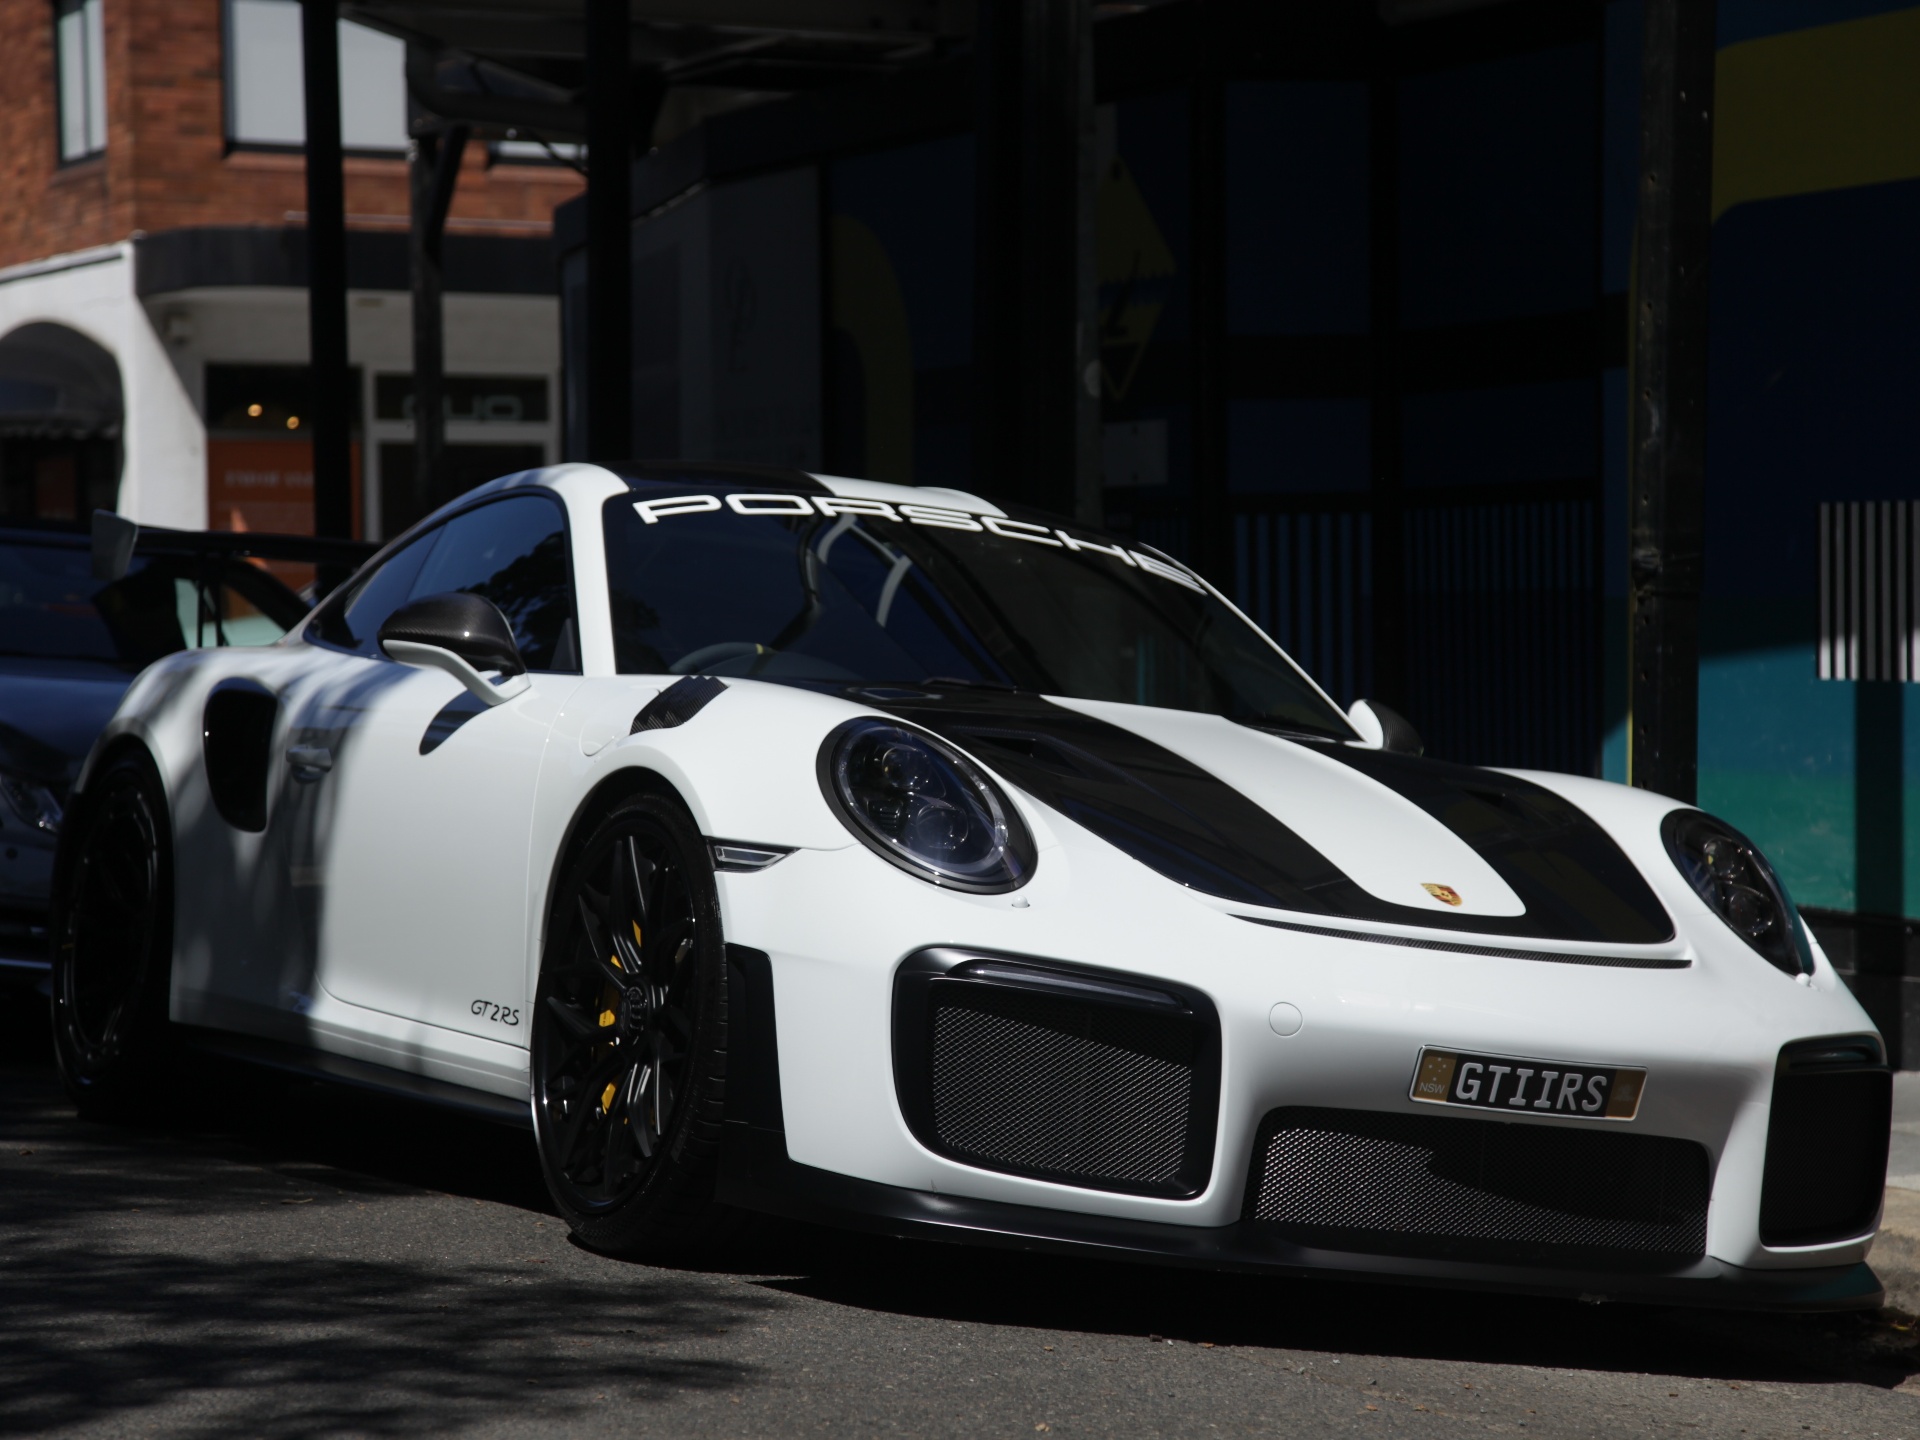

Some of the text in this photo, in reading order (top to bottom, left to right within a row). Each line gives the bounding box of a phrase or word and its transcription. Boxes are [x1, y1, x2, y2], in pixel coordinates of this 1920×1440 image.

[632, 494, 1208, 596] PORSCHE
[1418, 1082, 1445, 1094] NSW
[1455, 1062, 1608, 1112] GTIIRS
